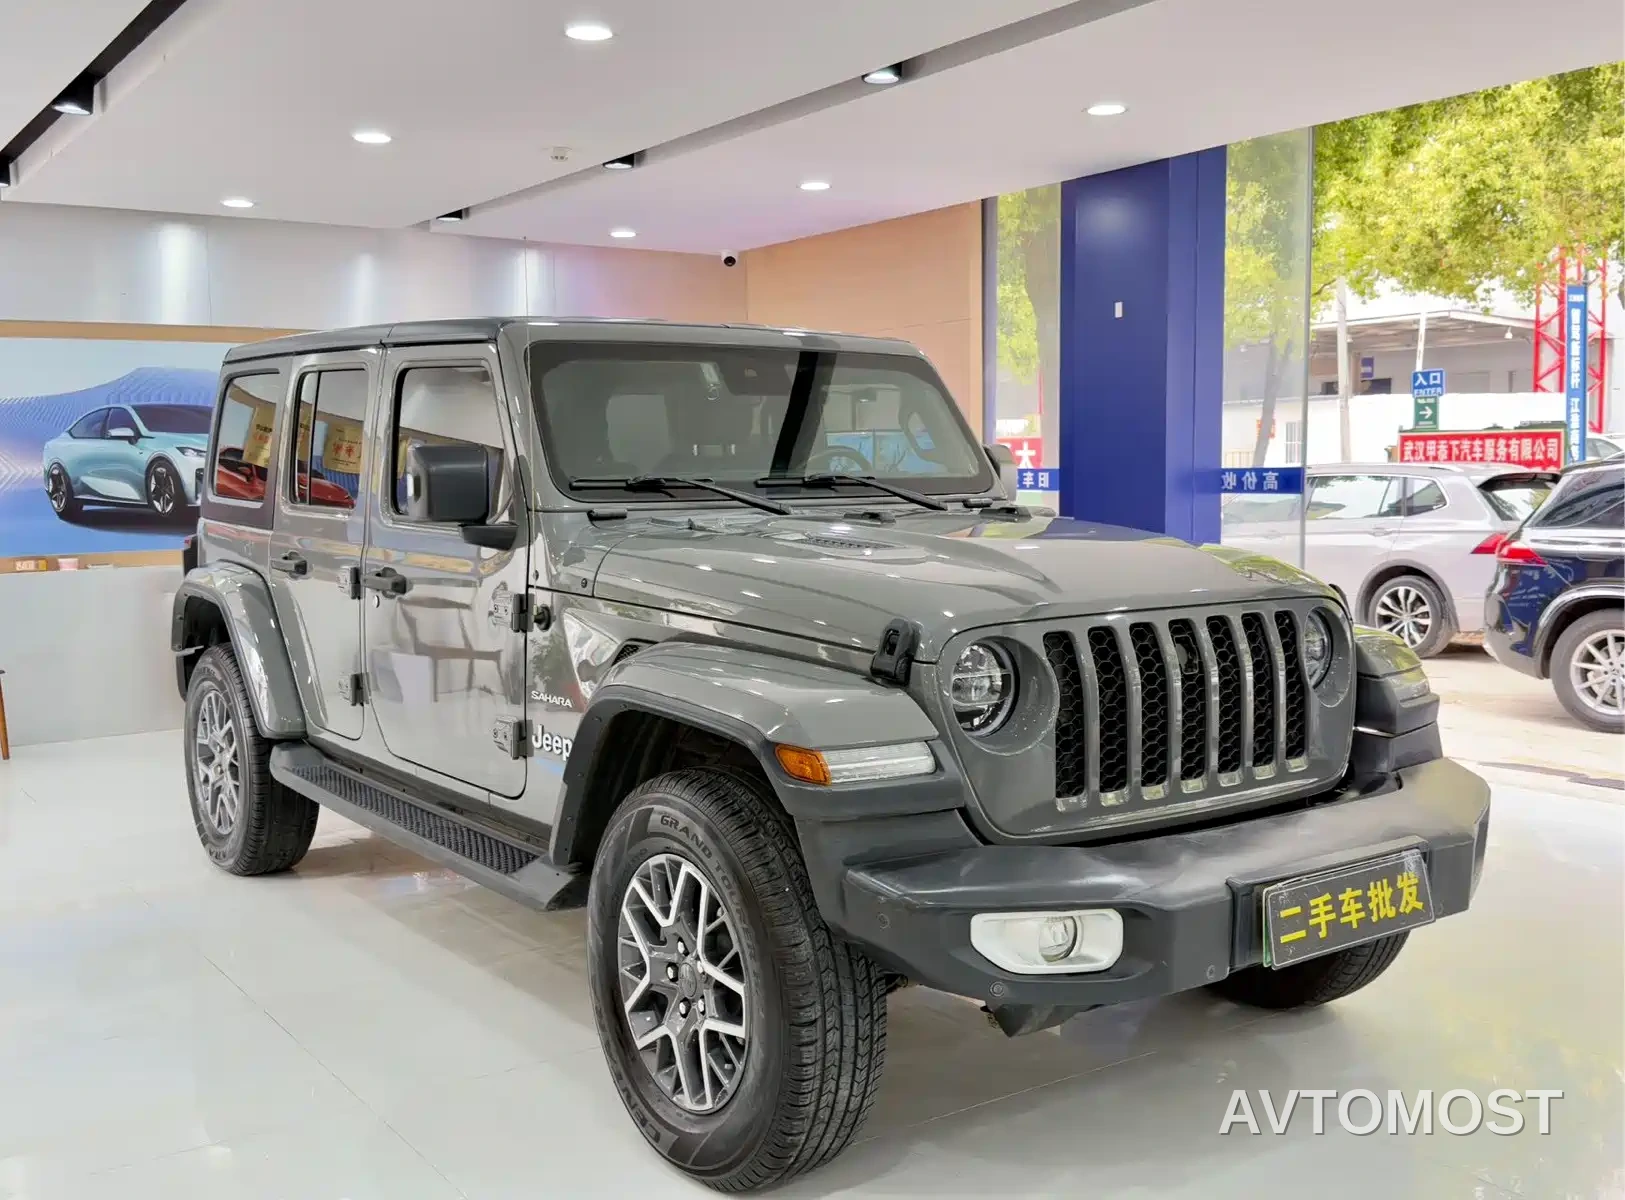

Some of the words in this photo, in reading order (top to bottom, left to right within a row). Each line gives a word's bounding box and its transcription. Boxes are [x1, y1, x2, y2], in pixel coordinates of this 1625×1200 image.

[1414, 372, 1441, 387] 入口
[531, 690, 572, 708] SAHARA
[531, 724, 574, 761] Jeep
[659, 814, 713, 860] GRAND
[1279, 871, 1424, 944] 二手车批发
